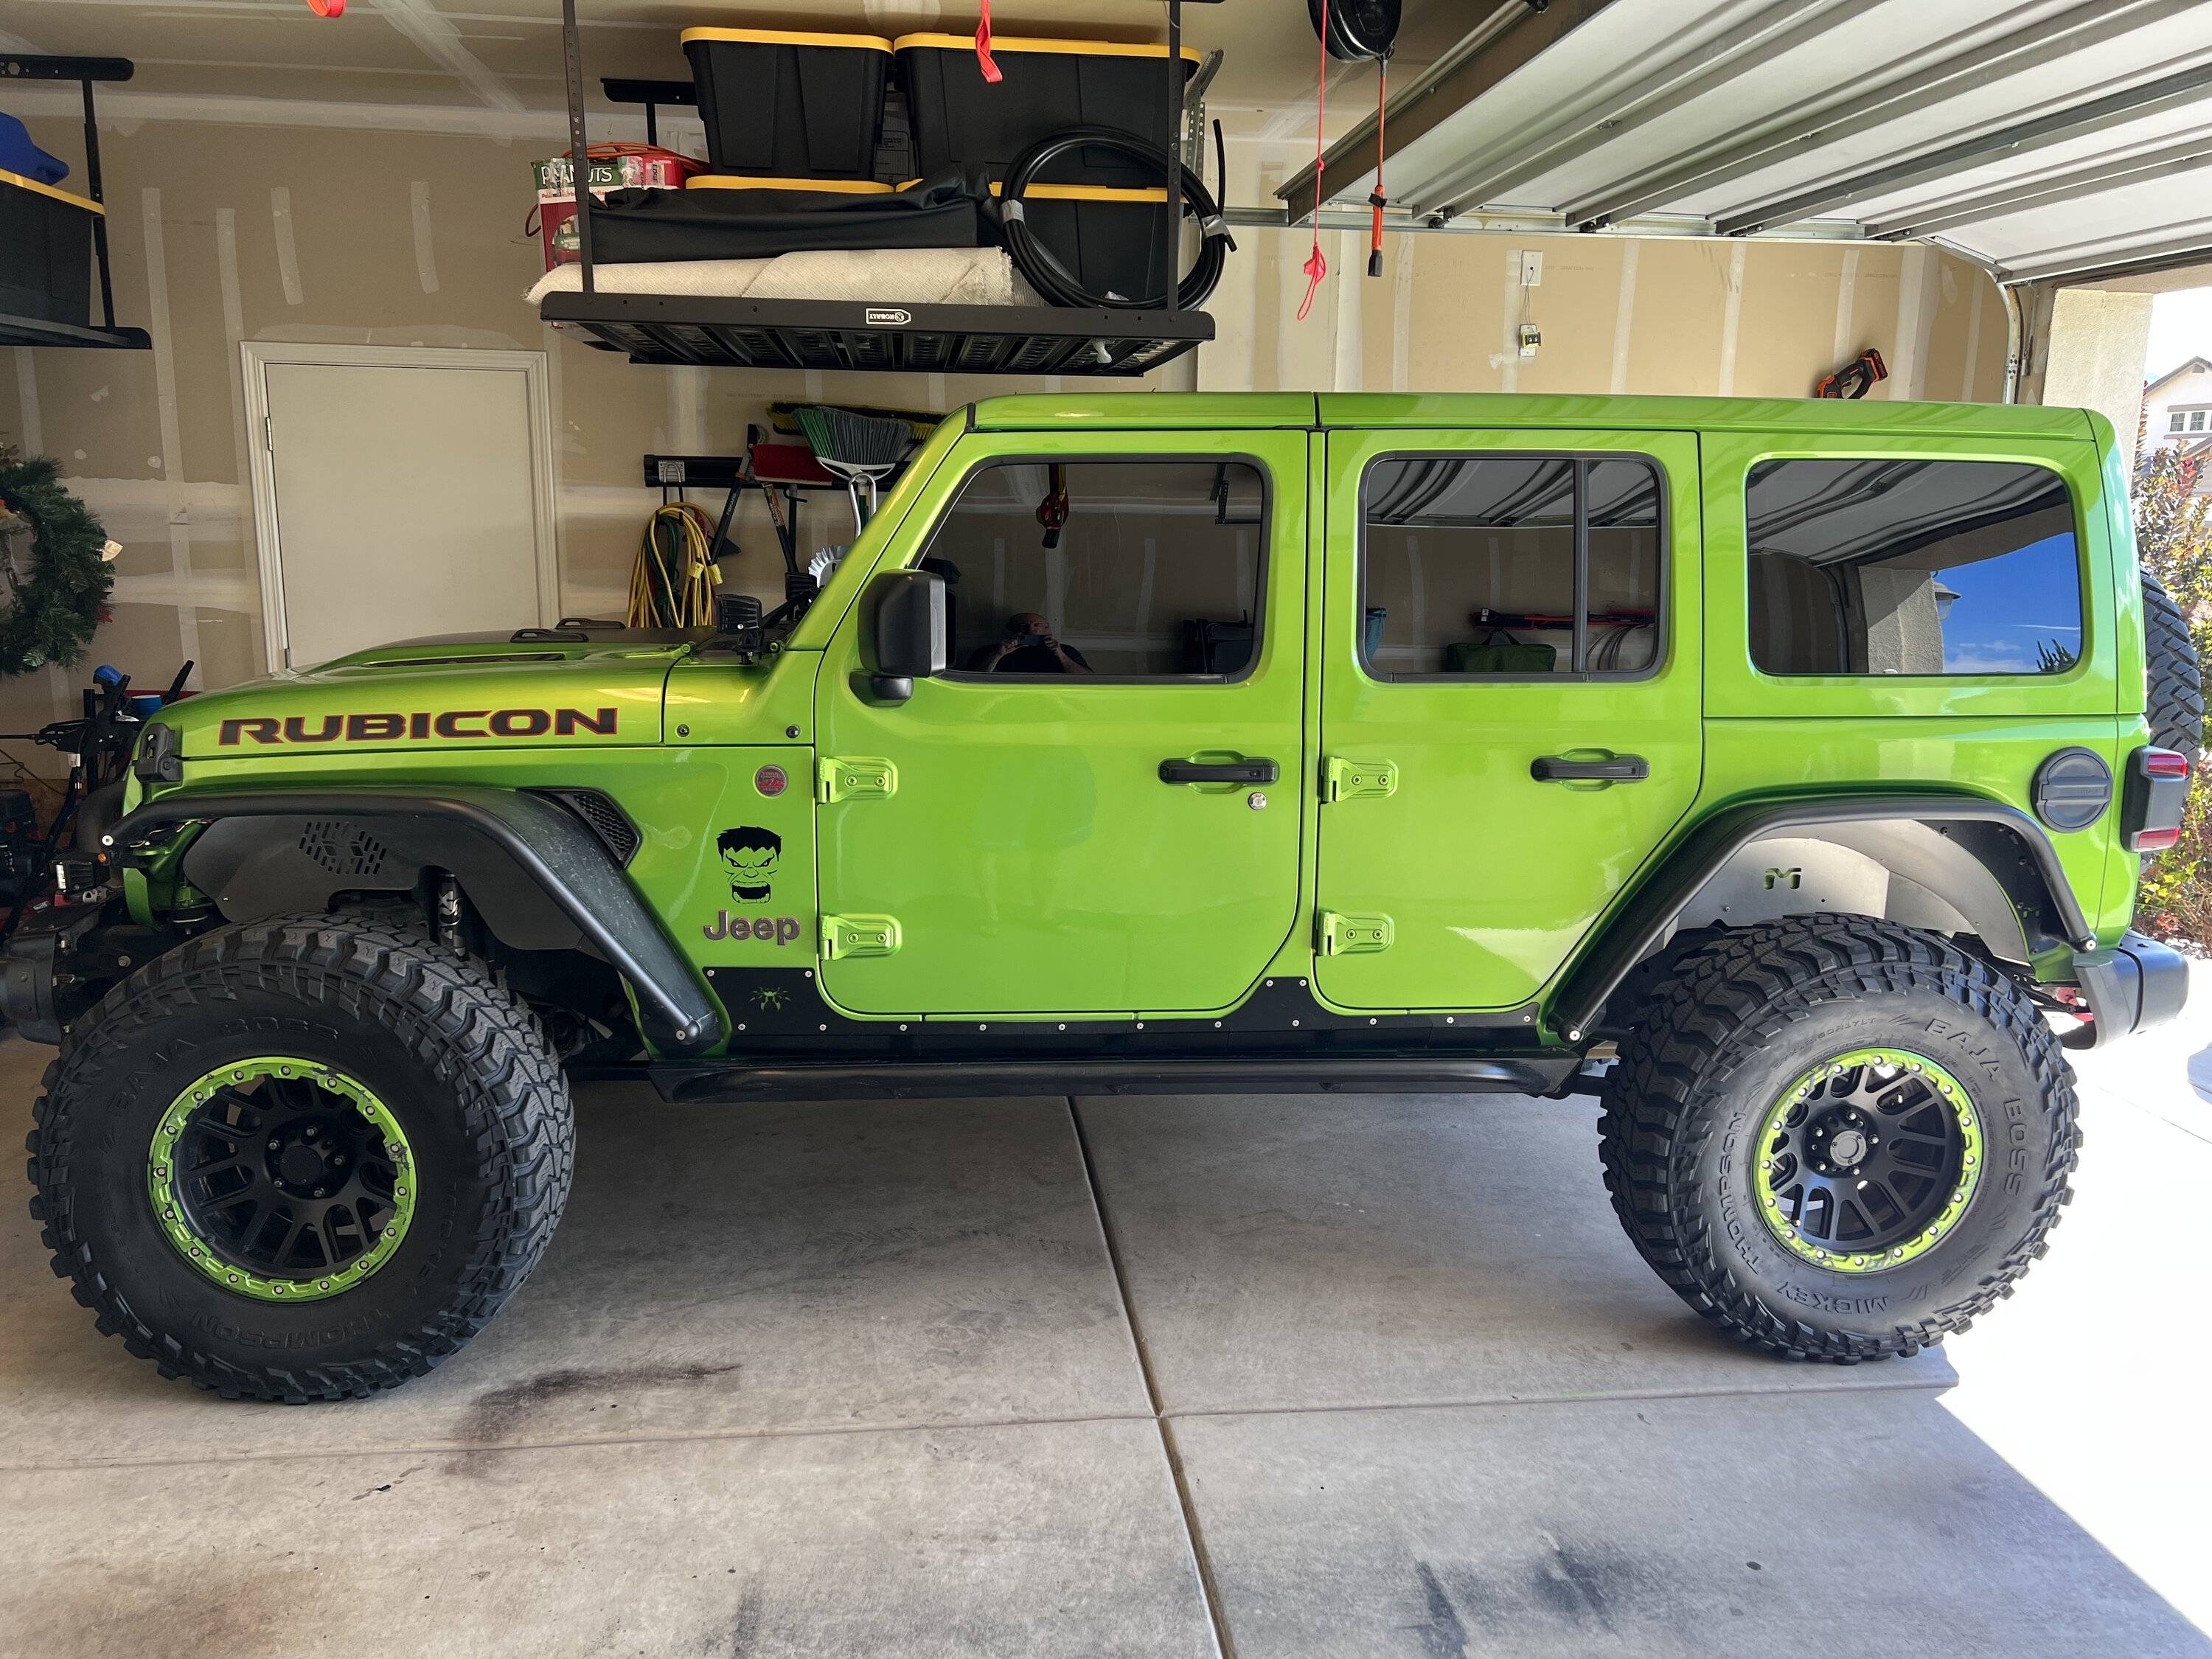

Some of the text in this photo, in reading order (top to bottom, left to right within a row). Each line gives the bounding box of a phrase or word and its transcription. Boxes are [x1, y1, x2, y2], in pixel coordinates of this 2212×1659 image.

[540, 164, 613, 186] PATS
[218, 707, 618, 746] RUBICON
[703, 910, 800, 946] Jeep
[1924, 1018, 2001, 1079] BAJA
[2003, 1098, 2028, 1196] BOSS
[1719, 1111, 1888, 1315] MICKEY THOMPSON
